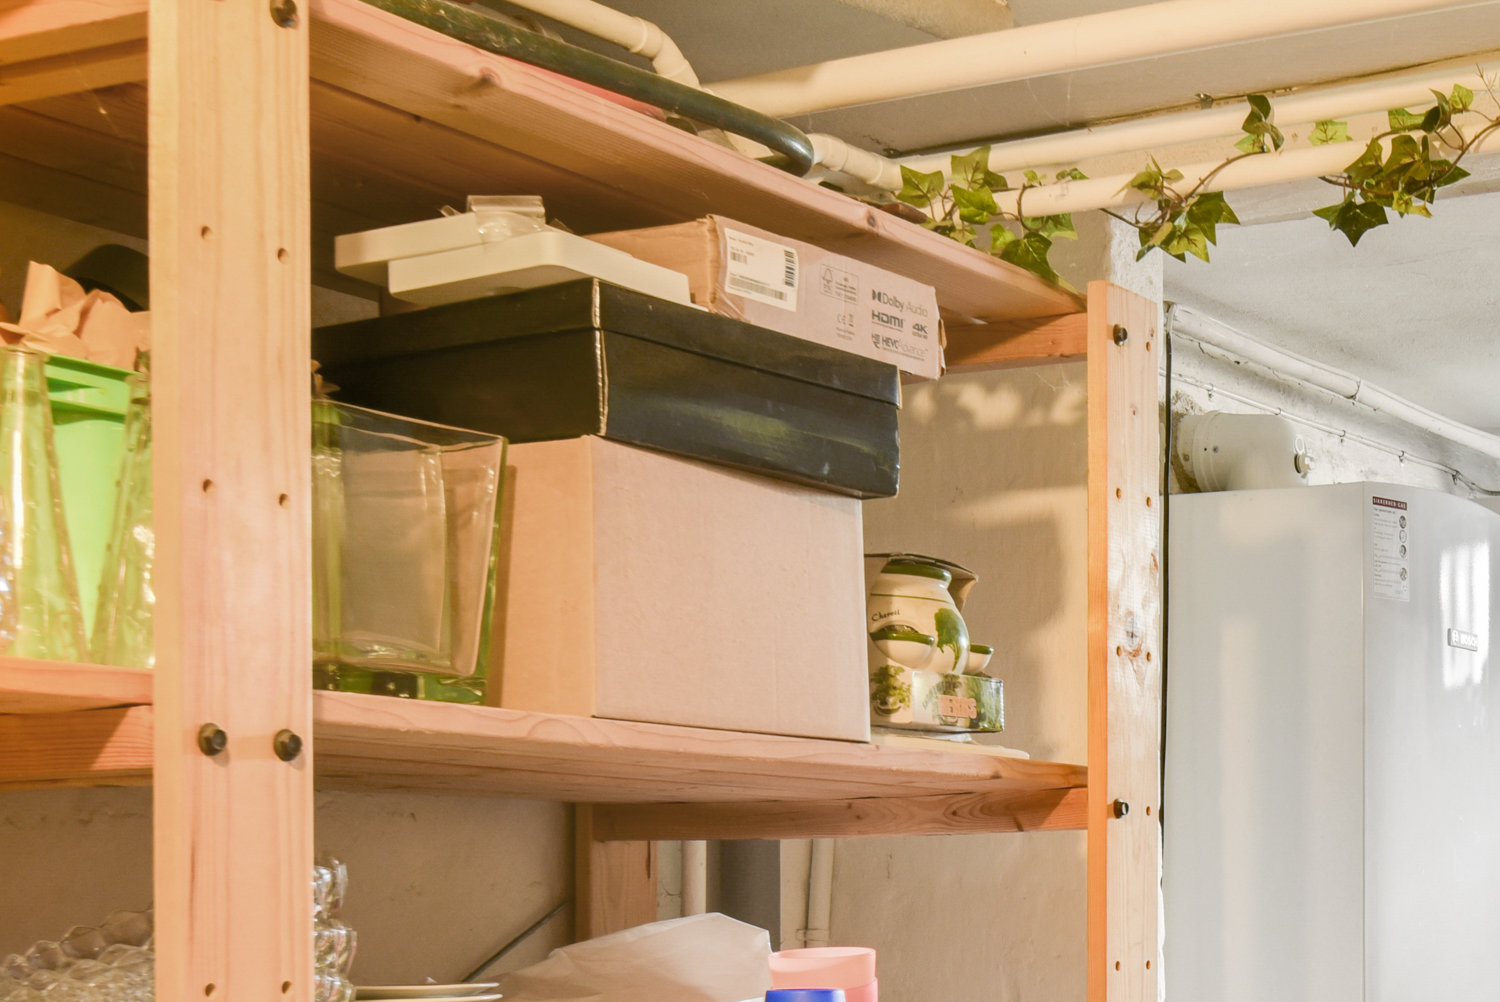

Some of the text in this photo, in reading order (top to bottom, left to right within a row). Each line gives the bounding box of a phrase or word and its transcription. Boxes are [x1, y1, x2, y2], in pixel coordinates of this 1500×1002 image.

[882, 292, 928, 317] Dolby Audio
[871, 310, 904, 328] HDMI
[912, 322, 928, 334] 4K
